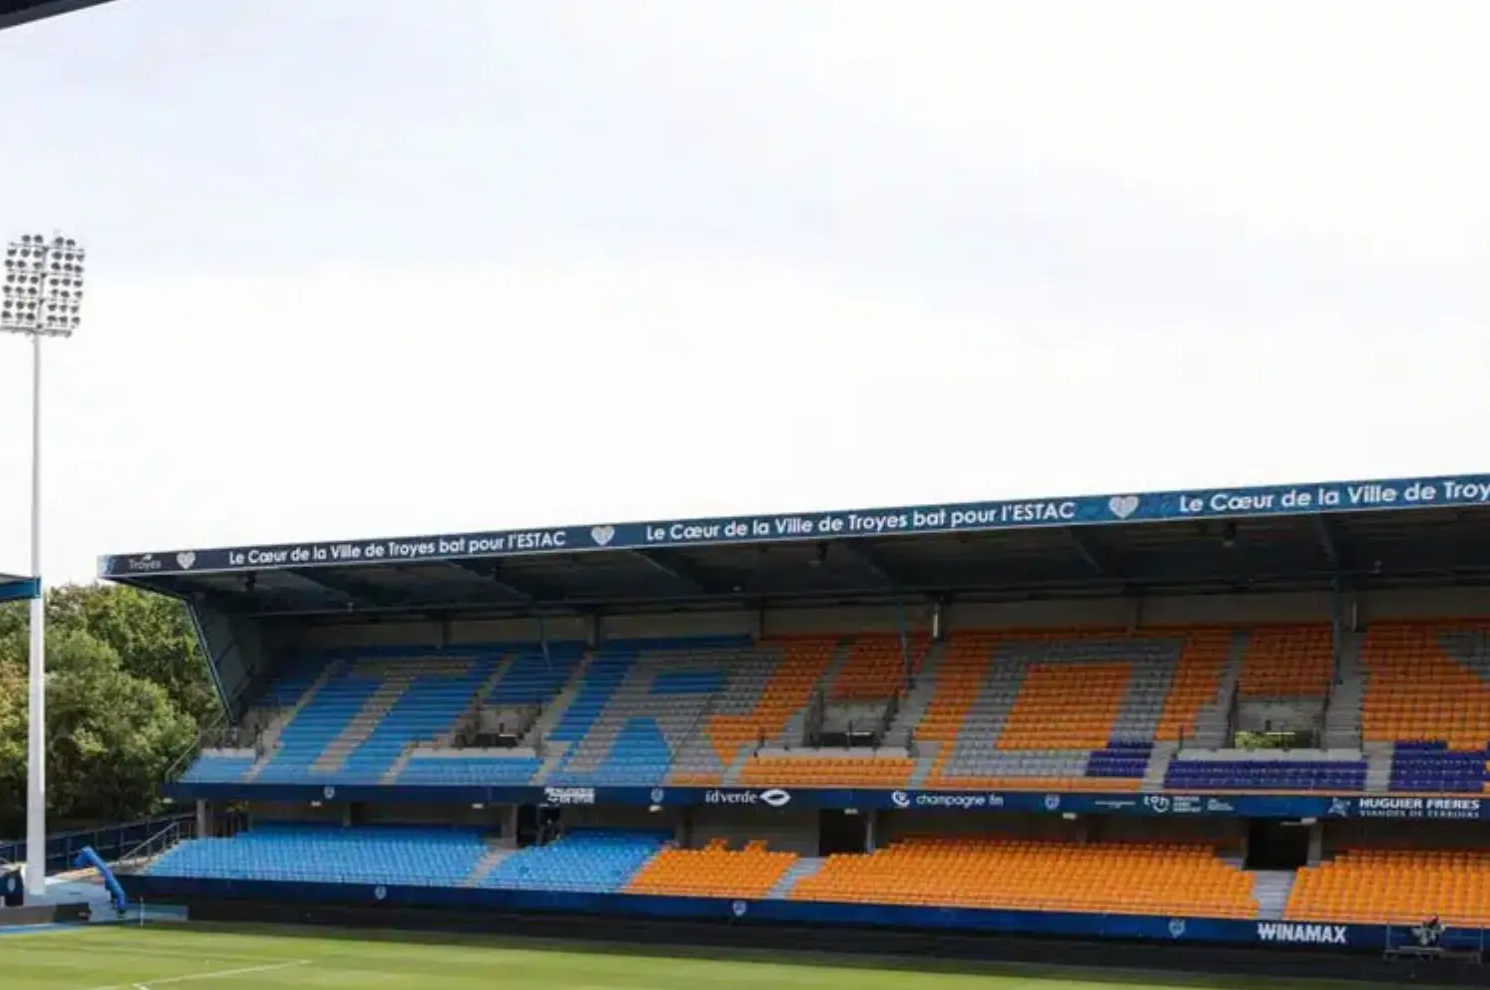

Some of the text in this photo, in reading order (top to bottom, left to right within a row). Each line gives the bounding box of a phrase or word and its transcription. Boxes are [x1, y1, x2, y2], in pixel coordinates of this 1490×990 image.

[1180, 495, 1202, 512] Le
[1210, 493, 1273, 511] Cœur
[1281, 490, 1311, 508] de
[1318, 487, 1339, 505] la
[1347, 483, 1397, 504] Ville
[1404, 481, 1437, 501] de
[647, 501, 1075, 541] Le Cœur de la Ville de Troyes bat pour l'ESTAC
[229, 531, 566, 565] Le Cœur de la Ville de Troyes bat pour l'ESTAC
[1359, 798, 1422, 809] HUGUIER
[1257, 922, 1348, 944] WINAMAX
